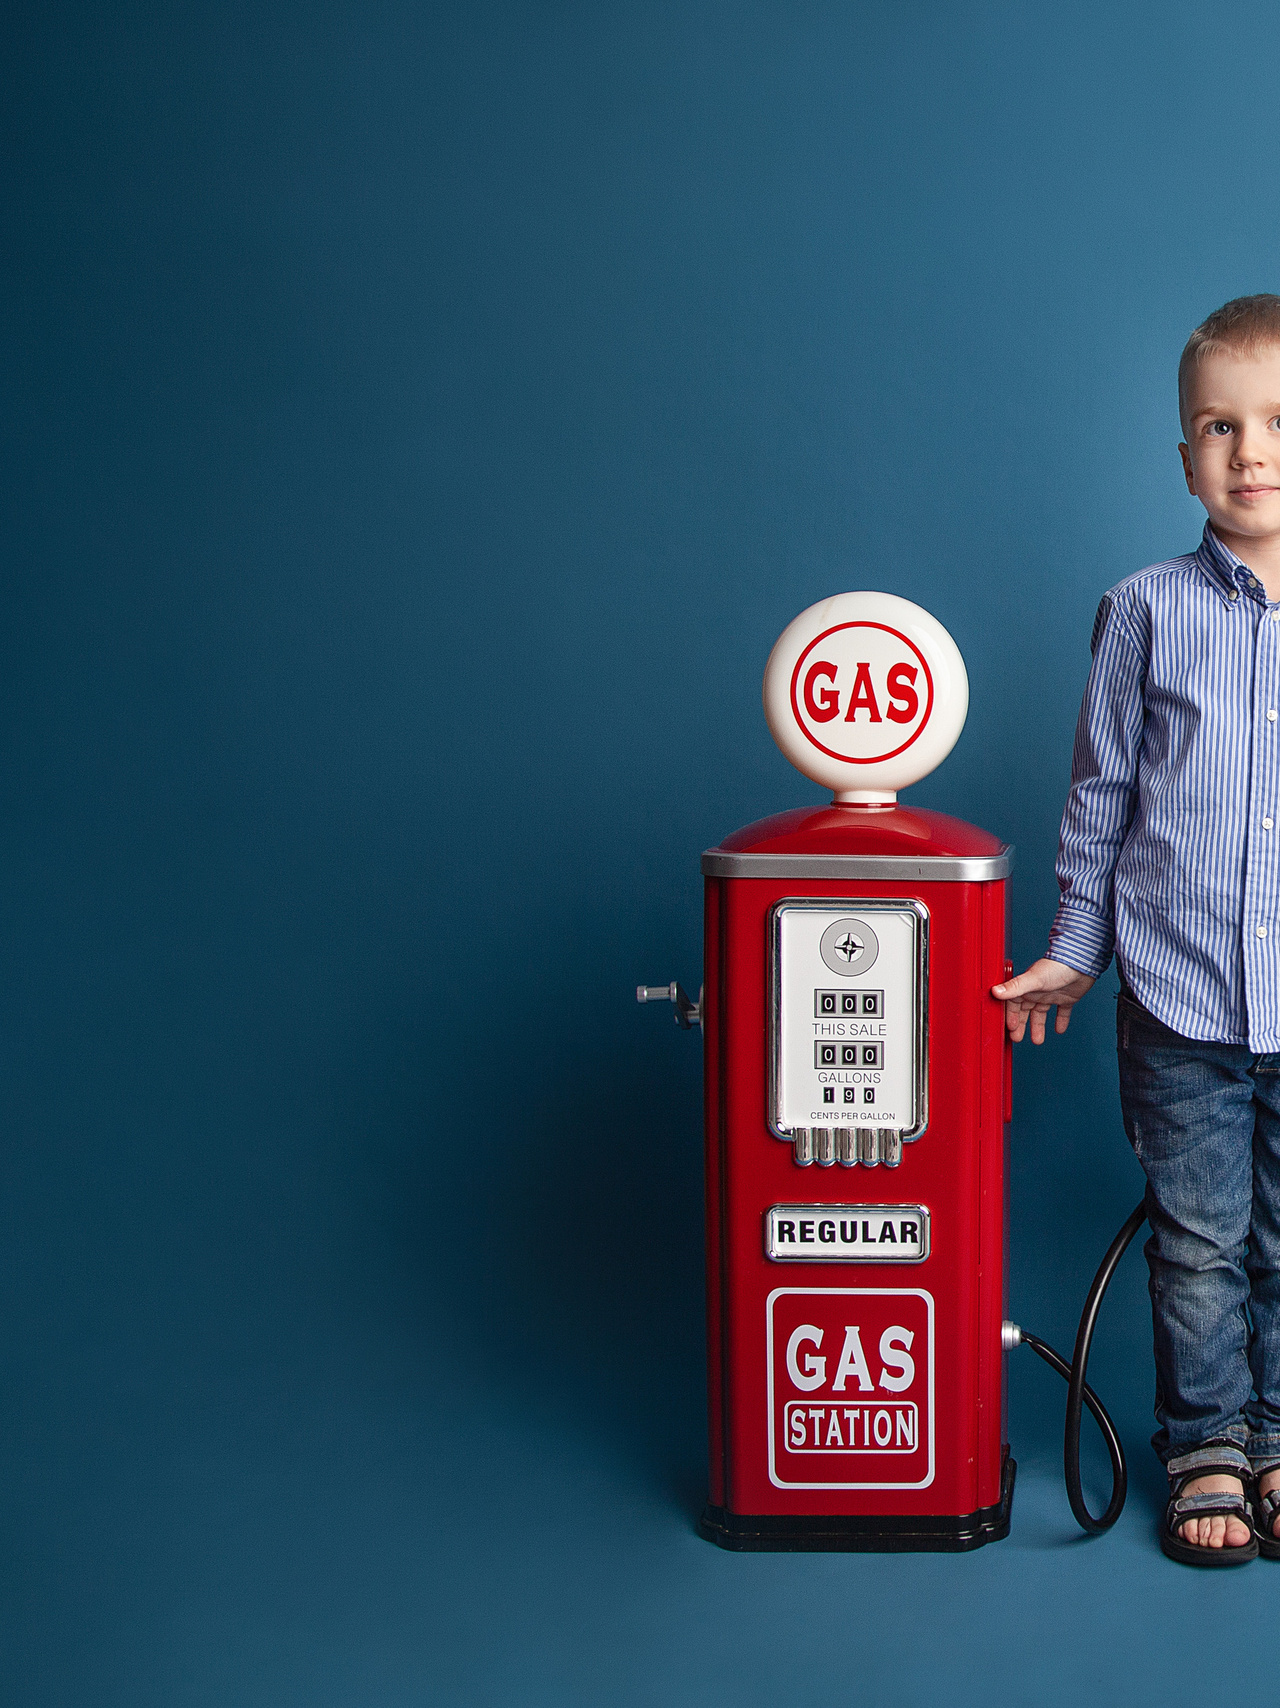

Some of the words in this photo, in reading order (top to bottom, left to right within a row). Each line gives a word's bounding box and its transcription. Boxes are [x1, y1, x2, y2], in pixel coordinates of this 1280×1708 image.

[803, 661, 919, 724] GAS
[812, 1023, 845, 1035] THIS
[849, 1023, 887, 1035] SALE
[818, 1072, 881, 1083] GALLONS
[810, 1111, 840, 1120] CENTS
[841, 1111, 859, 1120] PER
[860, 1111, 896, 1120] GALLON
[778, 1220, 918, 1243] REGULAR
[786, 1324, 916, 1392] GAS
[791, 1408, 914, 1446] STATION
